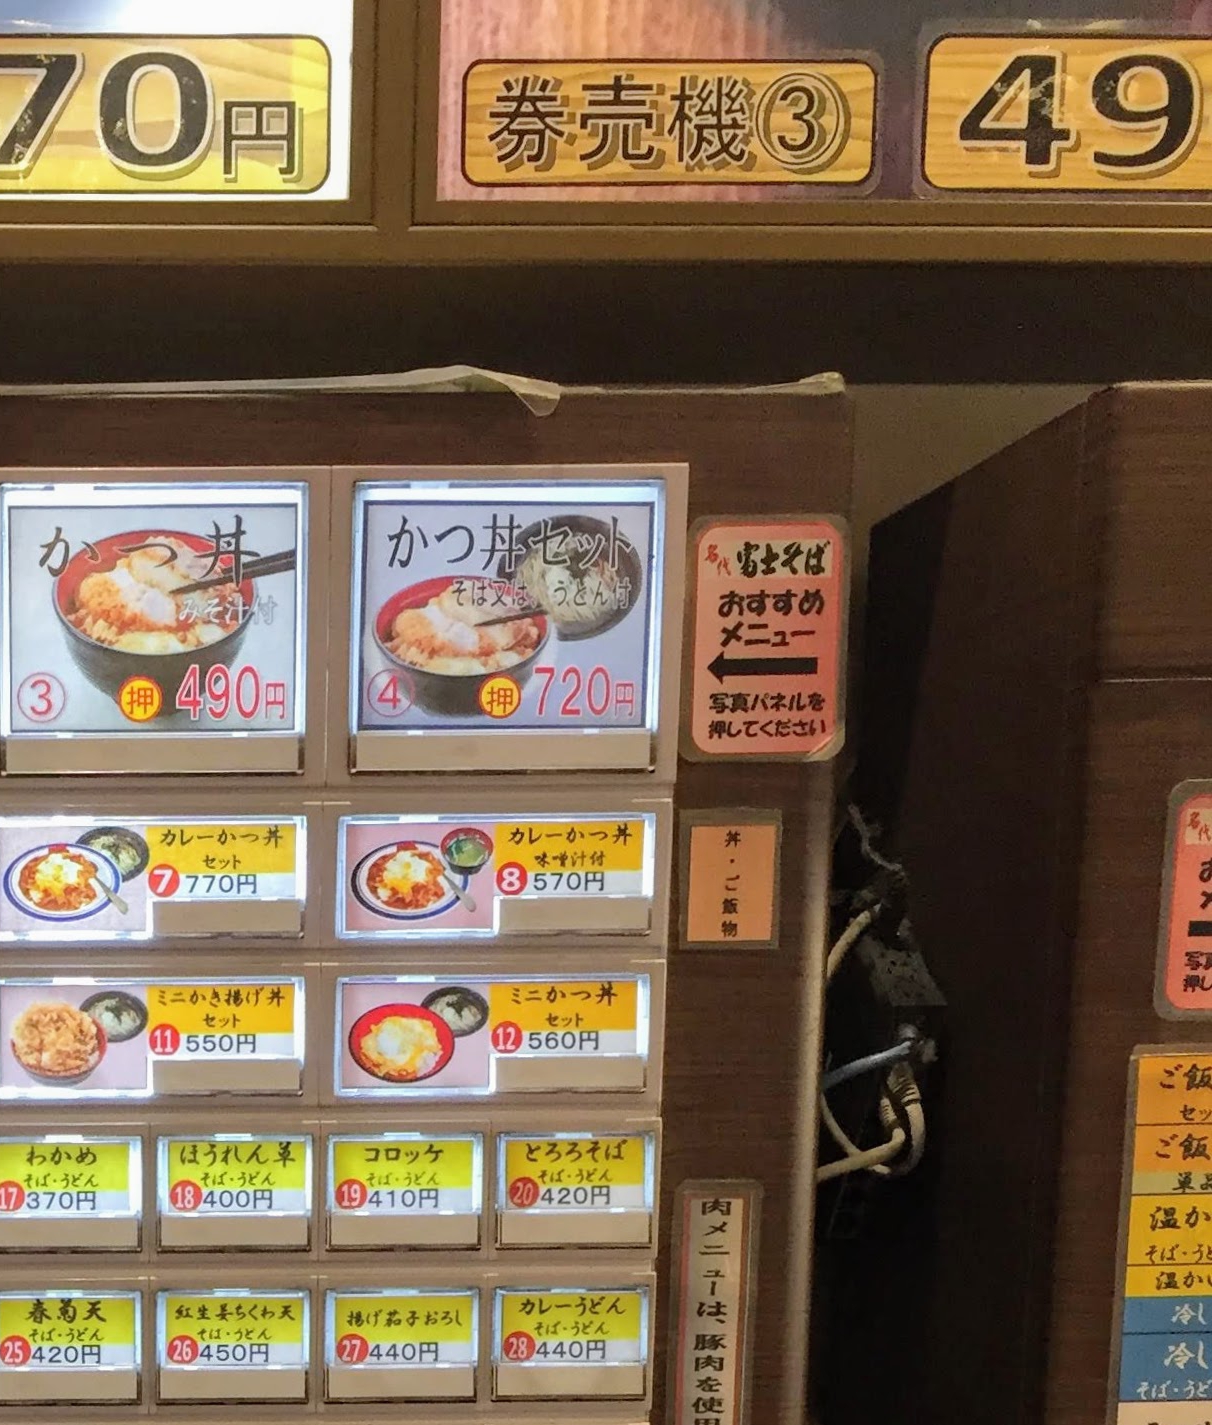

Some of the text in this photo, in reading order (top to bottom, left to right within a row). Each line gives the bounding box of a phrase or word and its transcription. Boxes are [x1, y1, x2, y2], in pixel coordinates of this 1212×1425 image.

[39, 514, 260, 588] かつ丼
[387, 514, 633, 572] かつ丼セット
[737, 541, 830, 578] 富士そば
[718, 589, 825, 616] おすすめ
[720, 621, 815, 647] メニュー
[126, 687, 155, 714] 押
[176, 664, 285, 720] 490円
[486, 687, 513, 714] 押
[534, 666, 634, 716] 720円
[709, 693, 825, 713] 写真パネルを
[708, 720, 826, 739] 押してください
[159, 825, 284, 848] カレーかつ丼
[508, 823, 632, 845] カレーかつ丼
[202, 855, 242, 869] セット
[187, 874, 258, 894] 770円
[533, 871, 604, 892] 570円
[157, 987, 285, 1008] ミニかき揚げ丼
[511, 982, 618, 1006] ミニかつ丼
[202, 1014, 241, 1028] セット
[545, 1013, 585, 1027] セット
[186, 1034, 256, 1054] 550円
[528, 1031, 599, 1050] 560円
[26, 1146, 97, 1166] わかめ
[180, 1141, 296, 1167] ほうれん草
[364, 1144, 444, 1164] コロッケ
[525, 1139, 628, 1162] とろろそば
[26, 1191, 96, 1210] 370円
[202, 1189, 273, 1209] 400円
[368, 1188, 439, 1208] 410円
[540, 1185, 611, 1205] 420円
[519, 1296, 626, 1316] カレーうどん
[31, 1344, 102, 1365] 420円
[200, 1344, 269, 1363] 450円
[369, 1342, 439, 1362] 440円
[536, 1339, 606, 1360] 440円
